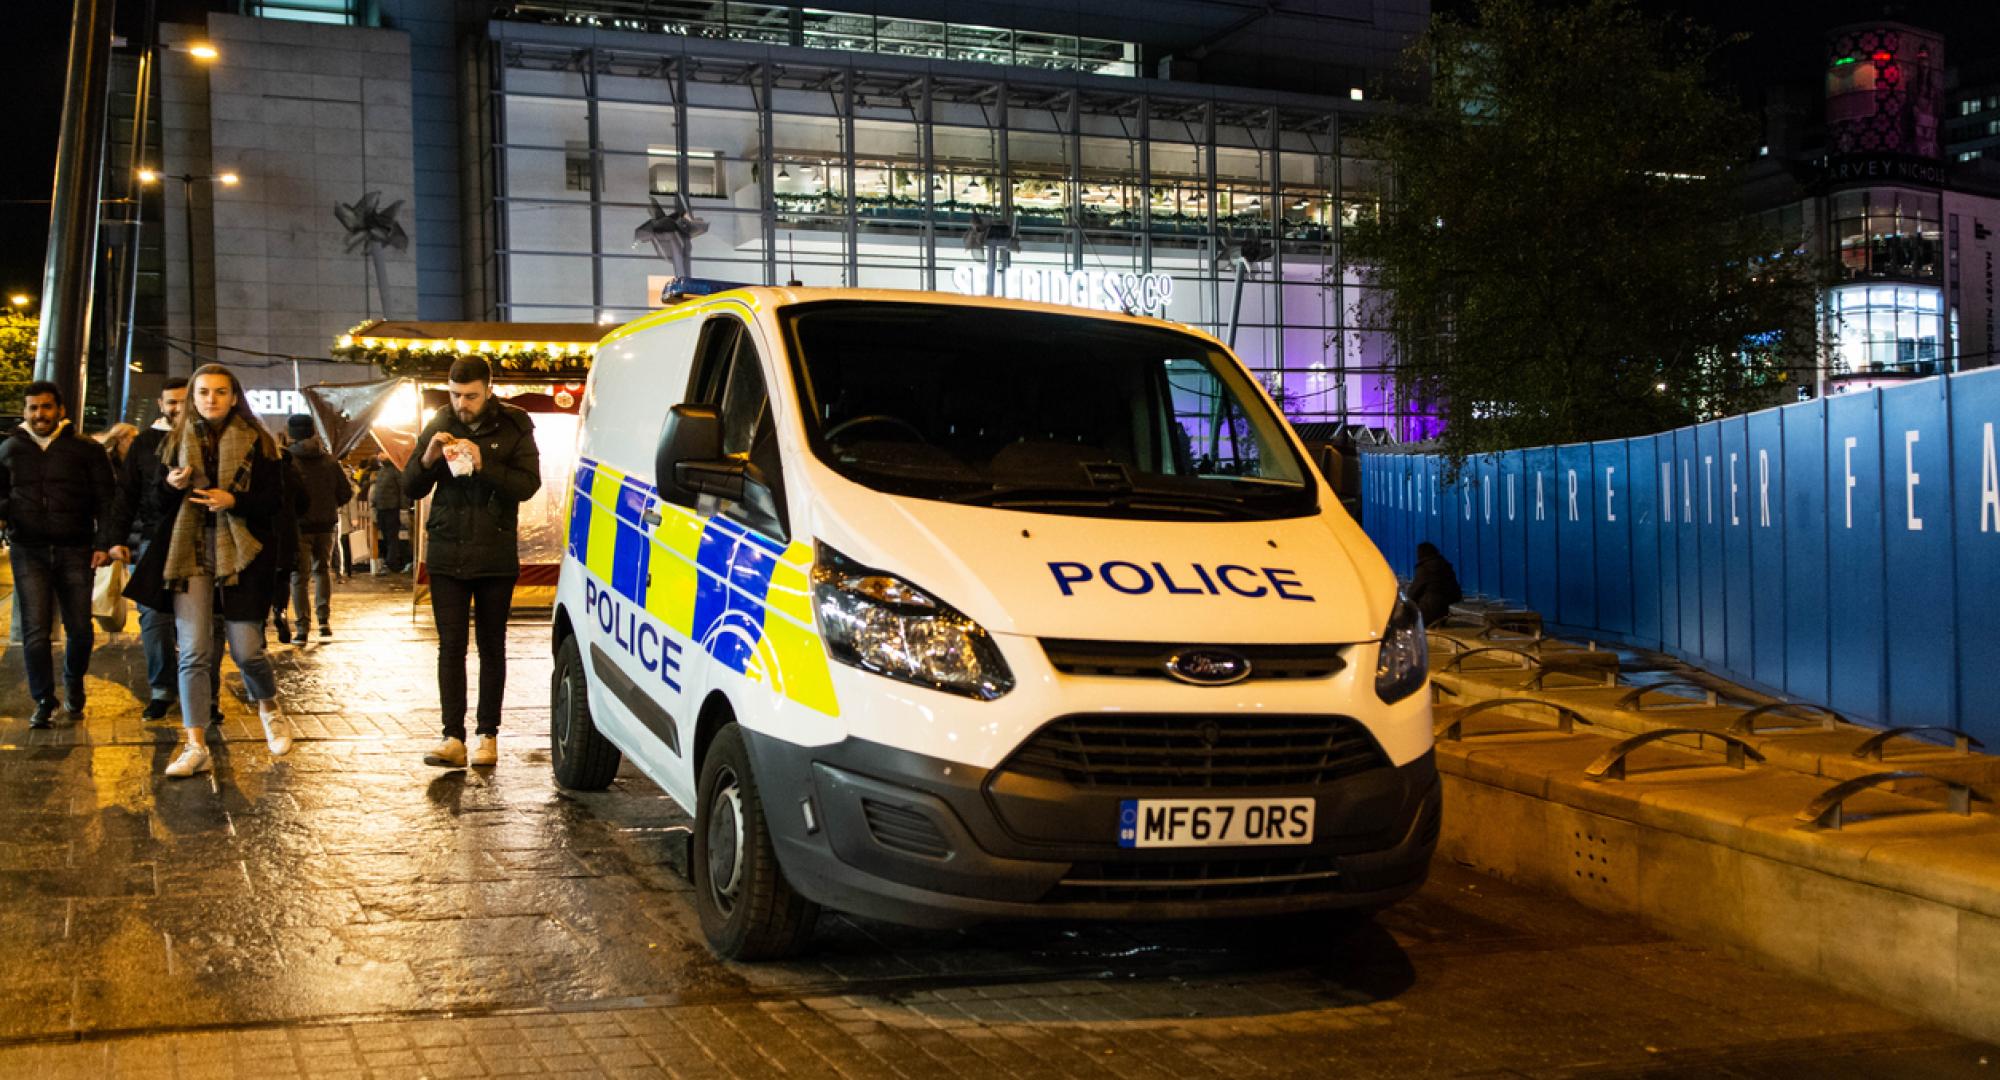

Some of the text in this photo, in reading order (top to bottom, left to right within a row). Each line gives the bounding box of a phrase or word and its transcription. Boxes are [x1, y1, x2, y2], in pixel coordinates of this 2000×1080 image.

[1464, 467, 1616, 525] SQUARE
[1662, 449, 1771, 527] WATER
[1047, 560, 1316, 602] POLICE
[586, 576, 683, 695] POLICE
[1144, 805, 1309, 841] MF67 ORS
